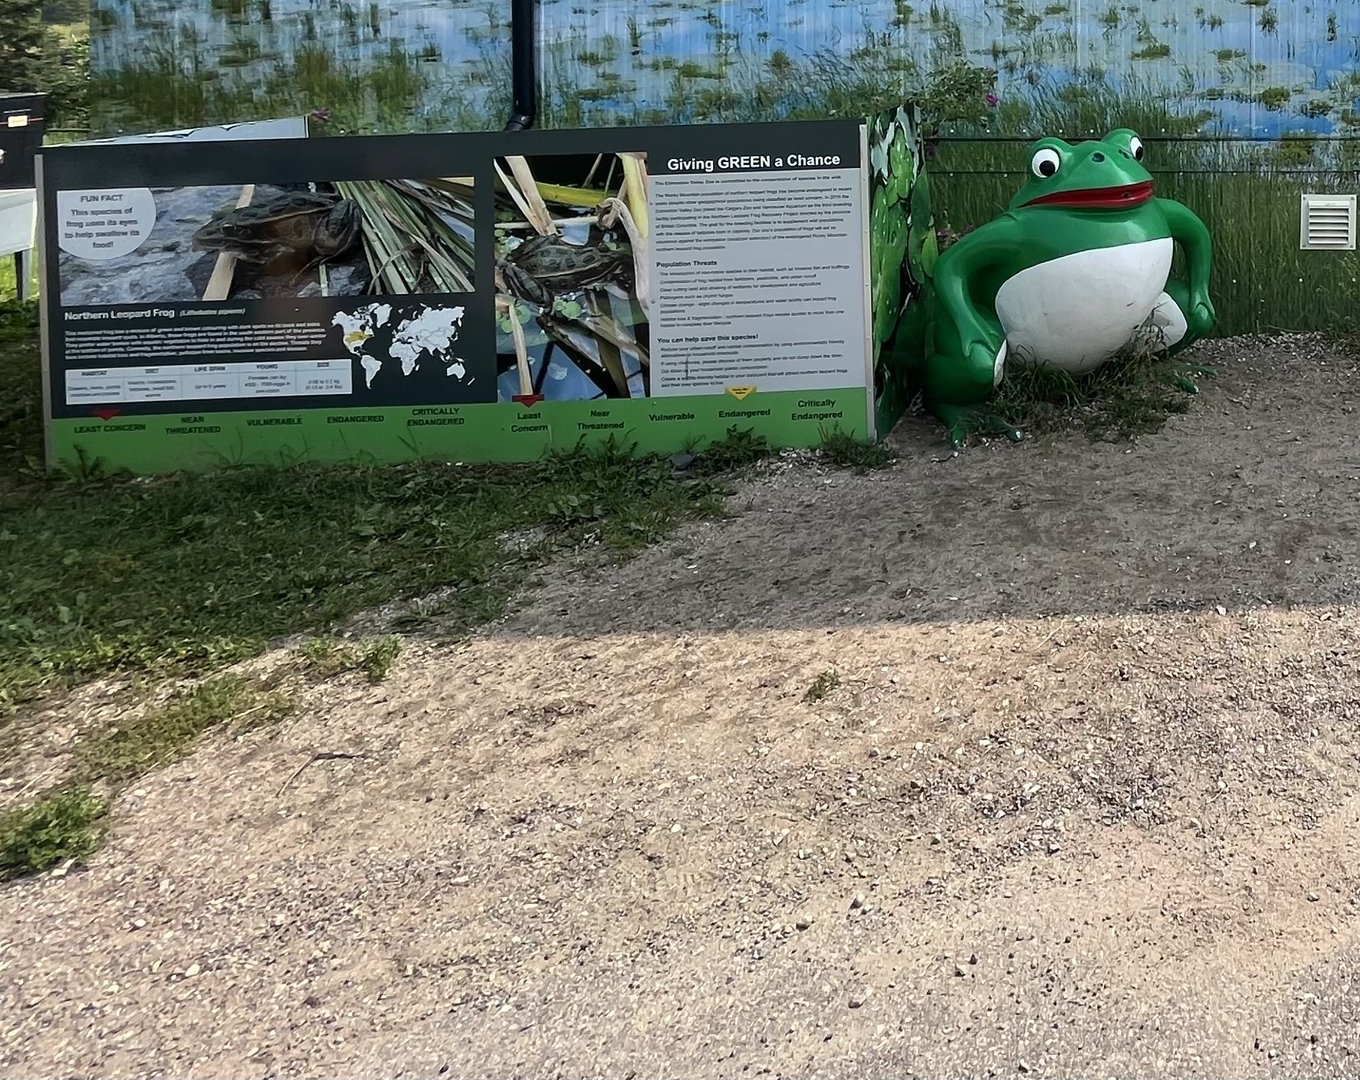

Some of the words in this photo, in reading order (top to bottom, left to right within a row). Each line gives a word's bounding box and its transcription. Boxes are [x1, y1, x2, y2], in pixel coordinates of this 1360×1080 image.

[668, 158, 713, 172] Giving
[718, 156, 770, 168] GREEN
[775, 158, 783, 166] a
[787, 155, 840, 166] Chance
[64, 312, 109, 320] Northern
[111, 310, 151, 319] Leopard
[153, 309, 175, 319] Frog
[797, 399, 836, 408] Critically
[412, 408, 459, 416] CRITICALLY
[517, 412, 541, 420] Least
[718, 409, 771, 419] Endangered
[791, 411, 843, 421] Endangered
[247, 417, 303, 426] VULNERABLE
[327, 415, 384, 424] ENDANGERED
[649, 412, 695, 422] Vulnerable
[407, 418, 465, 426] ENDANGERED
[577, 422, 624, 430] Threatened
[74, 426, 101, 434] LEAST
[103, 424, 146, 432] CONCERN
[165, 426, 221, 435] THREATENED
[511, 424, 548, 433] Concern
